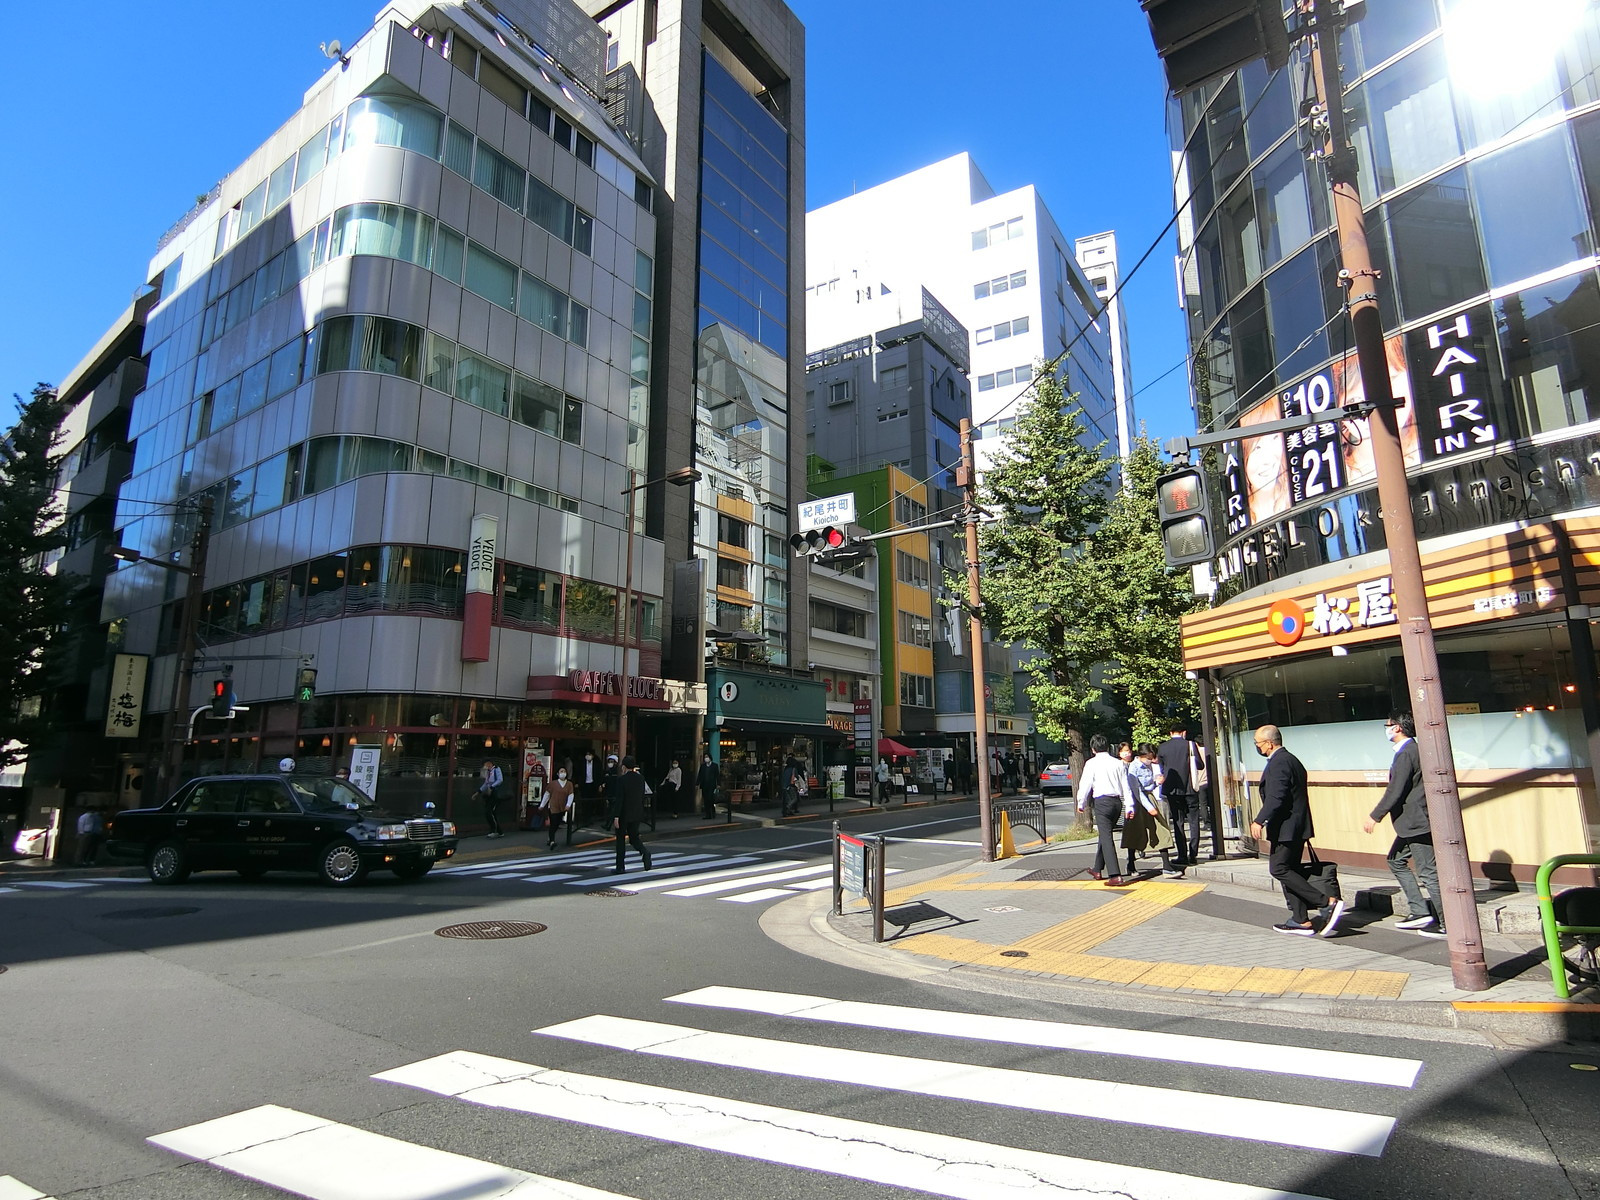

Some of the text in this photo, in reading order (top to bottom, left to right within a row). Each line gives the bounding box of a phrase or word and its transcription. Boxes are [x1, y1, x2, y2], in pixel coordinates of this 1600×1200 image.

[1427, 314, 1484, 430] HAIR
[1293, 374, 1331, 416] 10
[1434, 435, 1466, 455] IN
[1290, 456, 1303, 502] CLOSE
[1302, 440, 1339, 498] 21
[803, 498, 849, 518] 紀尾井町
[813, 514, 839, 526] Kioicho
[471, 536, 482, 572] VELOCE
[481, 538, 495, 573] VELOCE
[1311, 576, 1398, 636] 松屋
